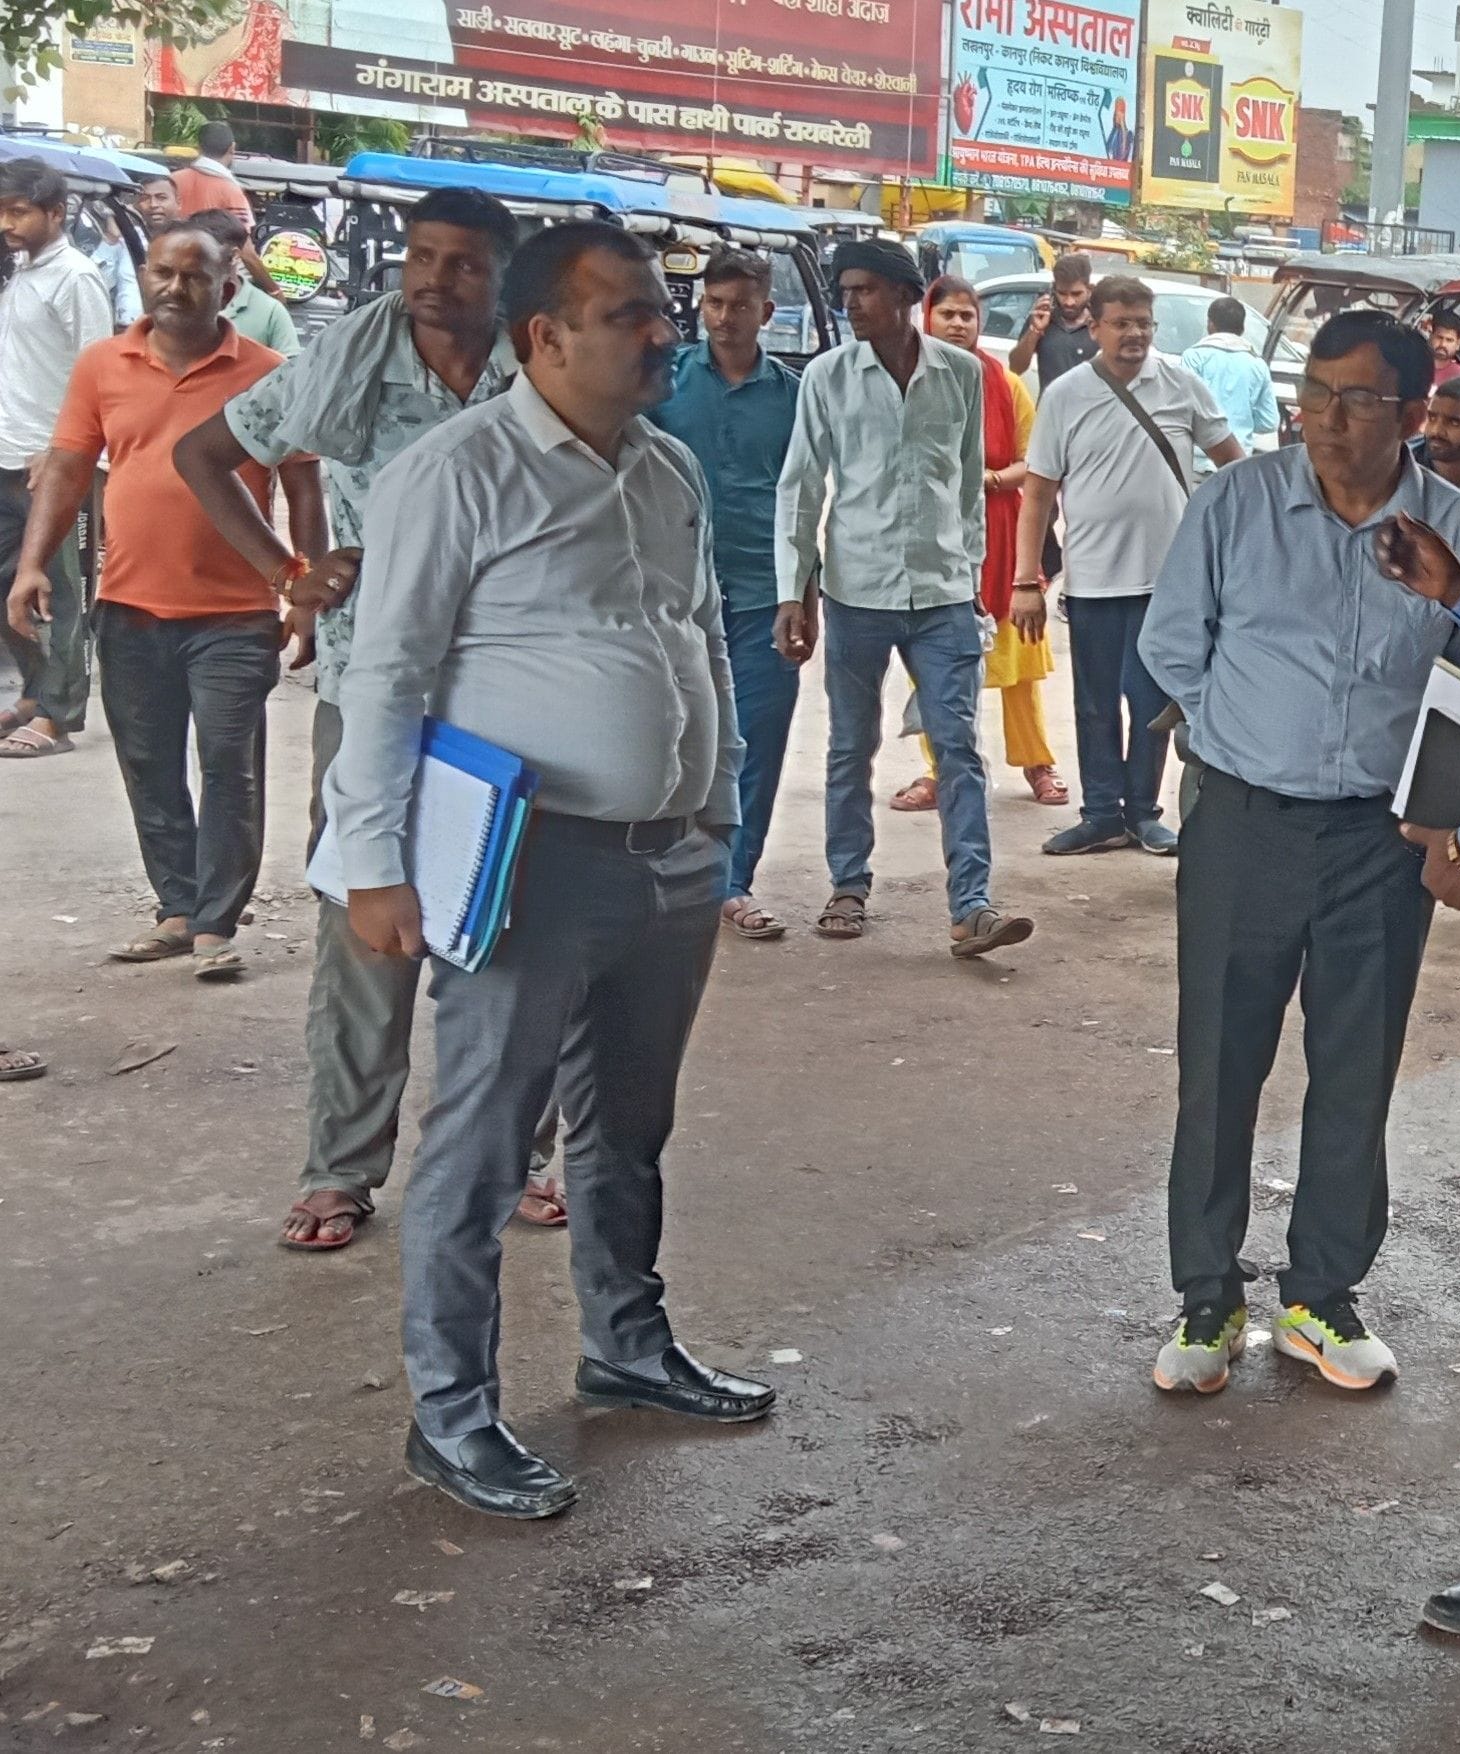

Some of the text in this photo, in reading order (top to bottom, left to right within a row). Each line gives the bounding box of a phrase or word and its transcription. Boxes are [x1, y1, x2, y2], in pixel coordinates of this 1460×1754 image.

[1023, 0, 1135, 58] अस्पताल
[1186, 2, 1234, 32] क्वालिटी
[1245, 18, 1271, 39] गारंटी
[456, 6, 493, 33] साड़ी
[680, 44, 717, 65] गाउन
[810, 57, 839, 83] मेन्स
[841, 61, 867, 87] वेयर
[874, 67, 917, 93] शेरवानी
[1001, 45, 1027, 65] कानपुर
[1054, 54, 1079, 74] कानपुर
[355, 58, 873, 149] गंगाराम अस्पताल के पास हाथी पार्क रायबरेली
[1006, 78, 1043, 96] हृदय रोग
[1170, 91, 1204, 121] SNK
[1236, 96, 1286, 142] SNK
[1236, 170, 1280, 187] PAN MASALA
[77, 510, 89, 550] JORDAN
